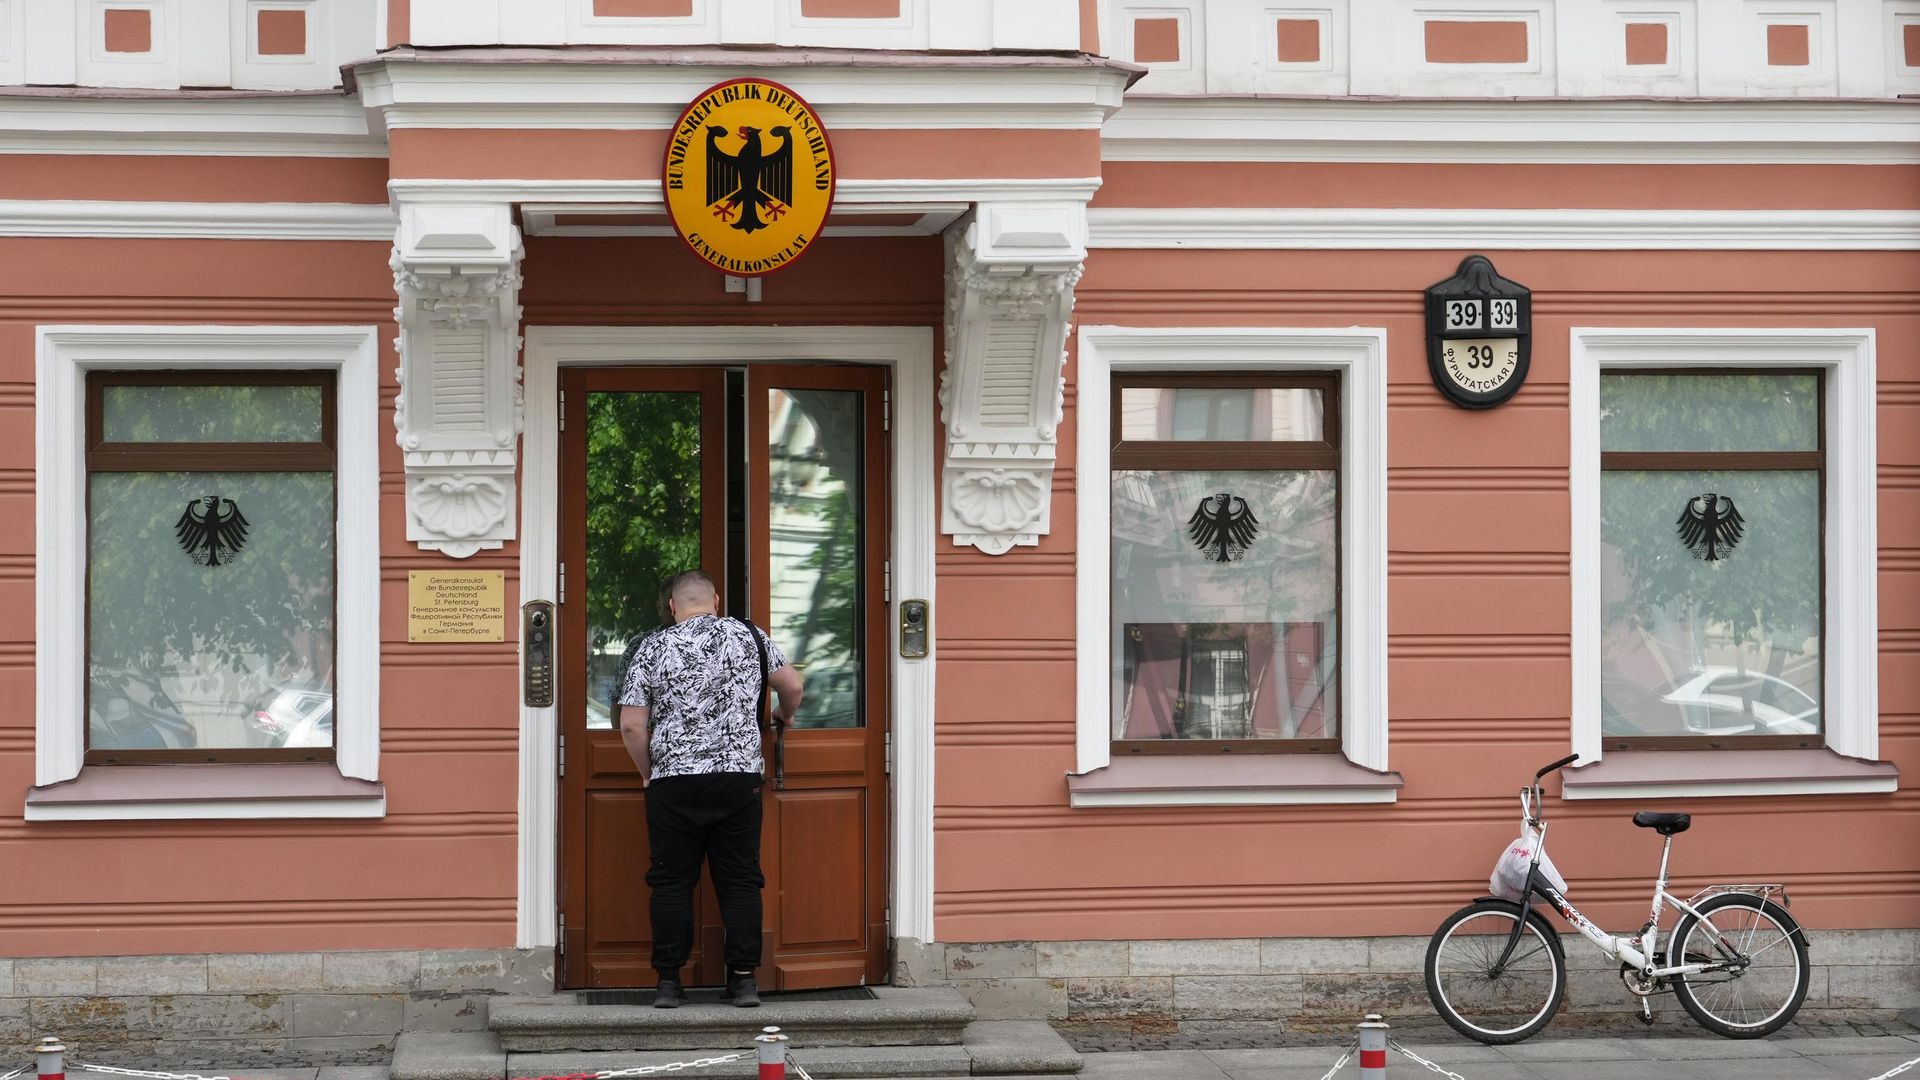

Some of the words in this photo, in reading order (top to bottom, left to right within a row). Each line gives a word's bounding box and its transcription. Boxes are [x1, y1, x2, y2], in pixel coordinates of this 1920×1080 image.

[669, 84, 763, 190] BUNDESREPUBLIK
[766, 87, 829, 190] DEUTSCHLAND
[688, 232, 808, 272] GENERALKONSULAT
[1451, 302, 1477, 326] 39
[1494, 301, 1514, 325] 39
[1447, 348, 1510, 389] ФУРШТАТСКАЯ
[1467, 345, 1494, 369] 39
[410, 613, 461, 621] Федеративной
[462, 613, 503, 621] Республики
[412, 606, 458, 614] Генеральное
[427, 627, 490, 635] Санкт-Петербурге
